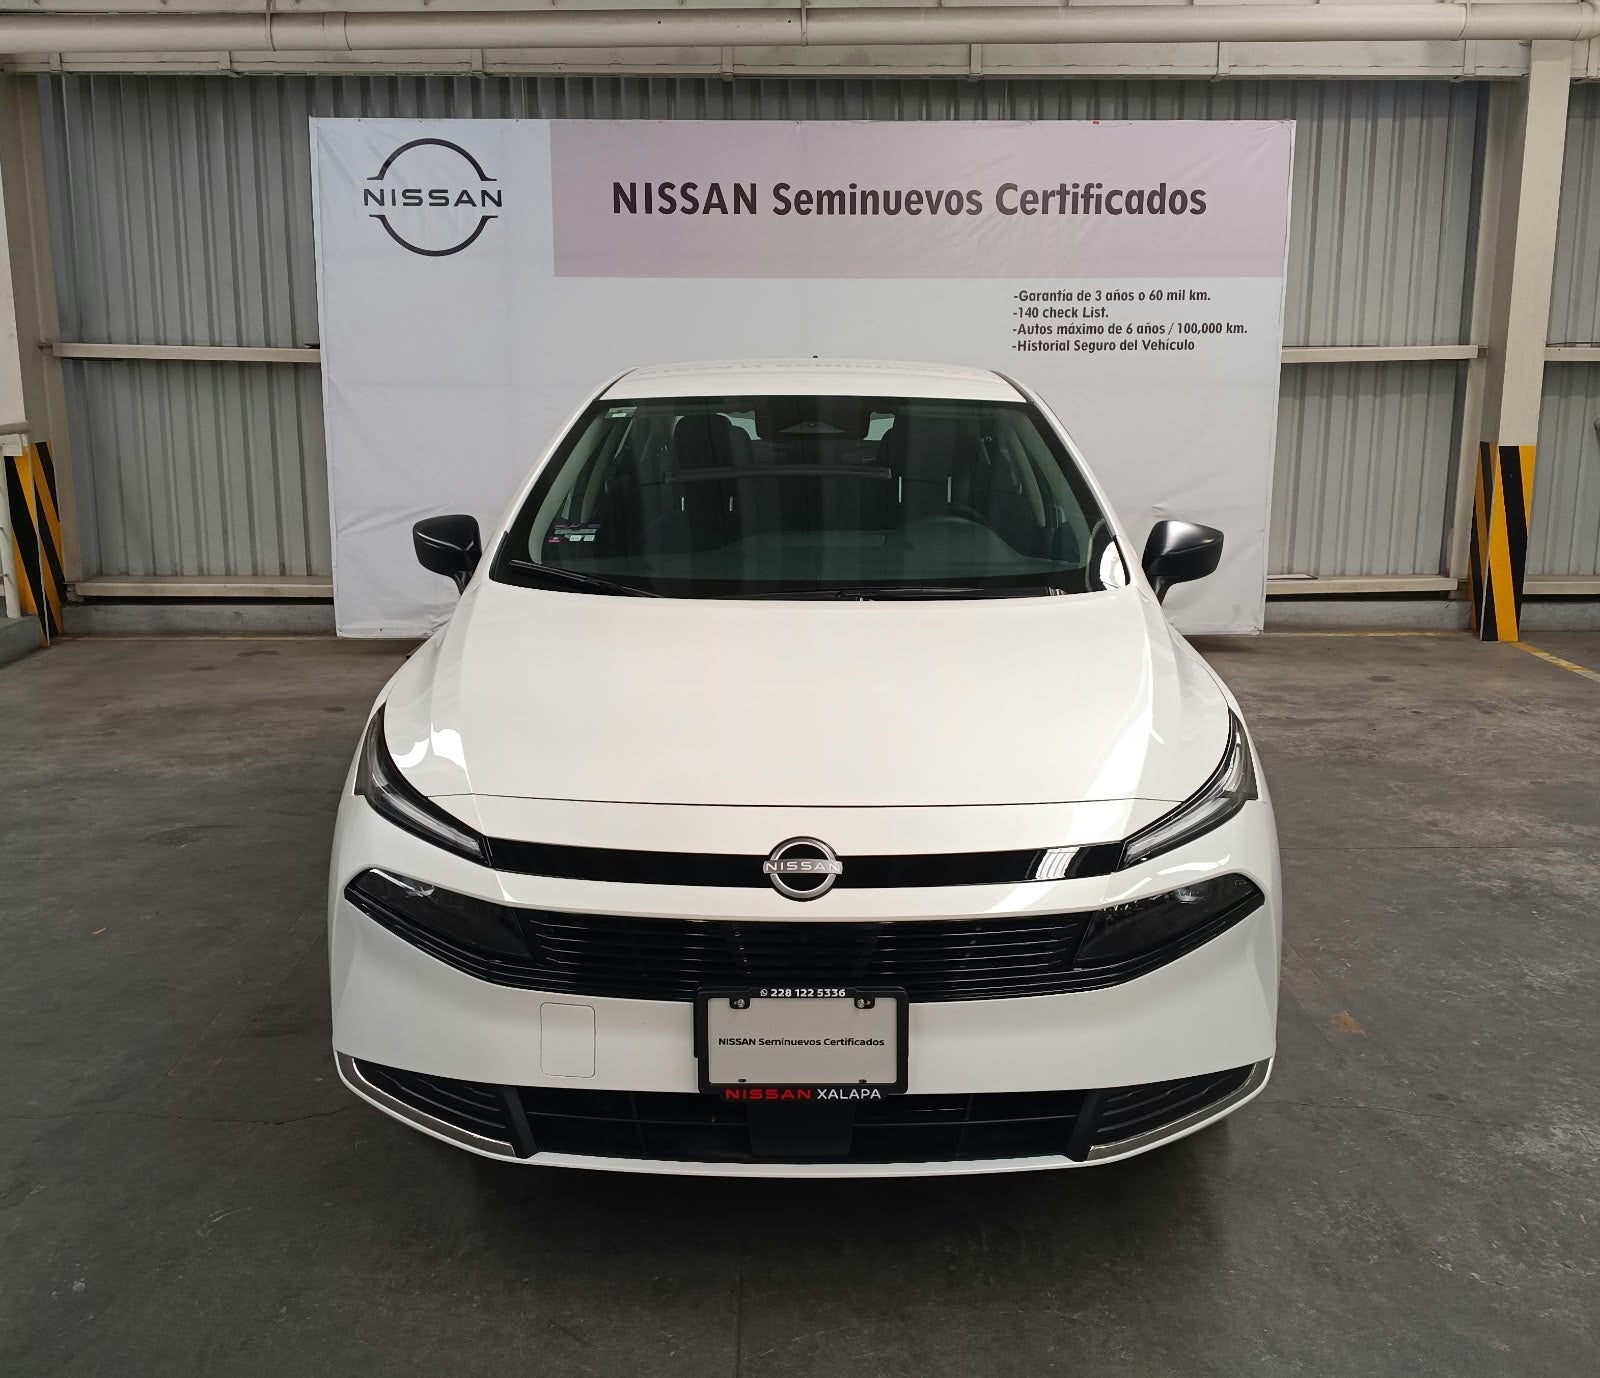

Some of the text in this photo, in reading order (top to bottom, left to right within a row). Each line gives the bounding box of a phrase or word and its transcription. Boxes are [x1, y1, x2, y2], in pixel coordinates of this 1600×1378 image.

[363, 188, 503, 208] NISSAN
[612, 182, 1207, 216] NISSAN Seminuevos Certificados
[1013, 289, 1211, 302] -Garantía de 3 años o 60 mil km.
[1013, 307, 1109, 318] -140 check List.
[1012, 322, 1248, 335] -Autos máximo de 6 años / 100,000 km.
[1011, 338, 1195, 353] -Historial Seguro del Vehículo
[765, 861, 840, 871] NISSAN
[770, 988, 846, 998] 228 122 5336
[718, 1037, 885, 1047] NISSAN Seminuevos Certificados
[725, 1088, 882, 1100] NISSAN XALAPA
